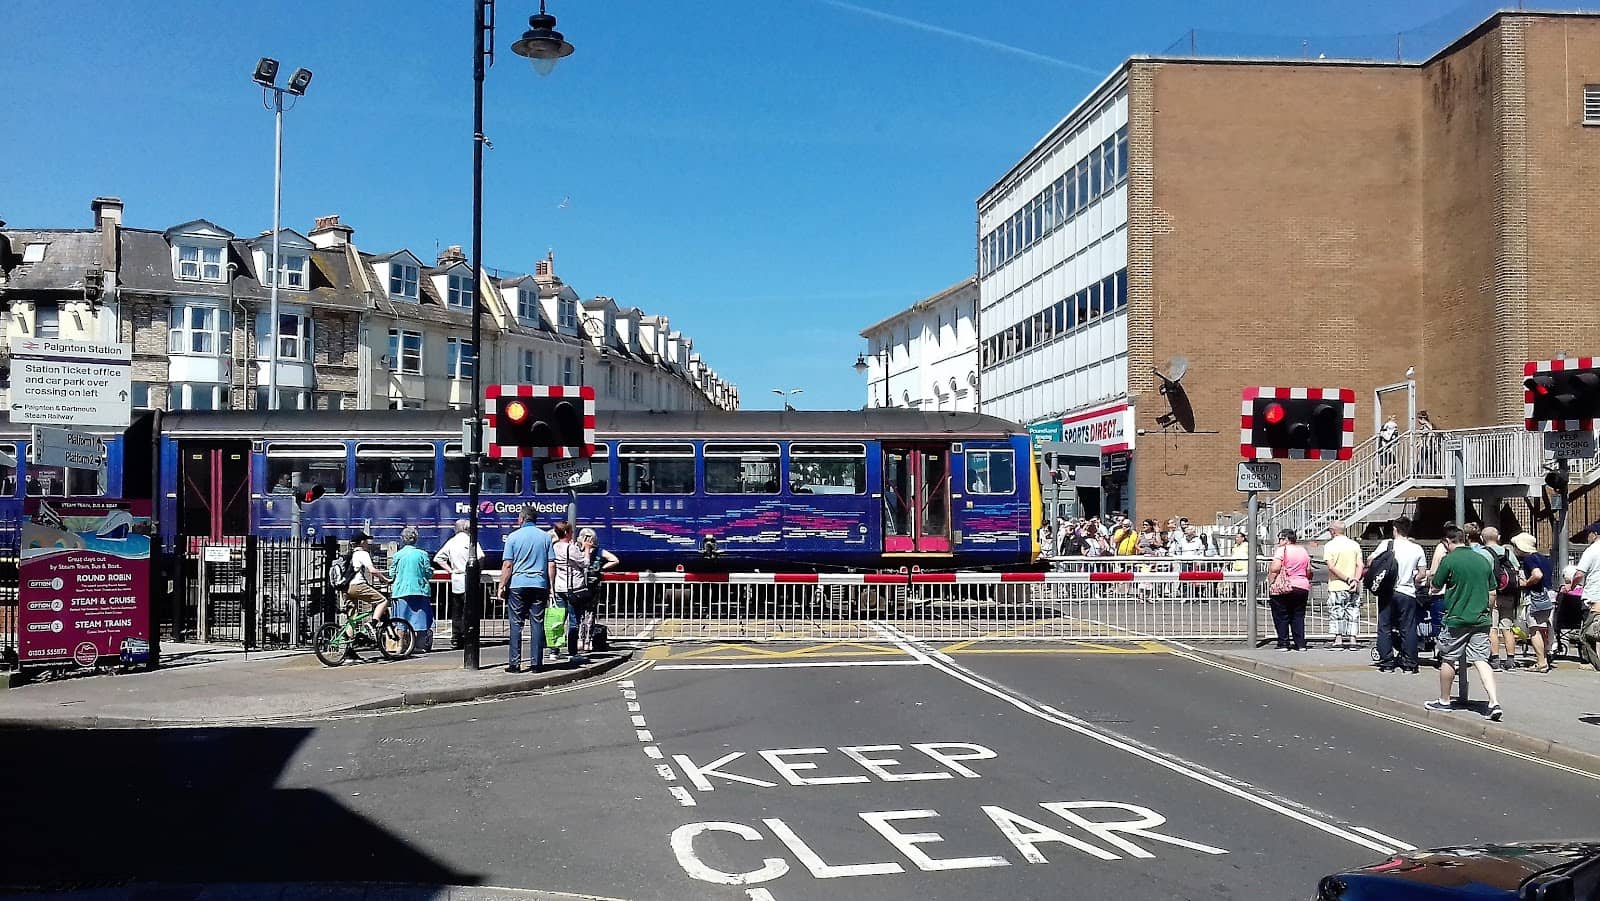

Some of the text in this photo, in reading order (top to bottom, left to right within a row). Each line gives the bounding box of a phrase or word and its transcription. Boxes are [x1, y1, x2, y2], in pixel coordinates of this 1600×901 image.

[44, 343, 122, 355] Paignton Station
[25, 364, 121, 376] Station Ticket office
[25, 376, 44, 384] and
[63, 378, 85, 388] park
[25, 388, 67, 397] crossing
[83, 389, 98, 397] left
[24, 404, 55, 412] Paignton
[24, 412, 74, 421] Steam Railway
[67, 433, 92, 447] Platform
[65, 451, 94, 465] Platform 2
[555, 461, 576, 469] KEEP
[1251, 465, 1269, 473] KEEP
[547, 466, 587, 480] CROSSING
[556, 477, 581, 486] CLEAR
[1248, 481, 1271, 489] CLEAR
[455, 501, 480, 513] Fir
[526, 501, 569, 513] Wester
[76, 573, 132, 582] ROUND ROBIN
[71, 597, 97, 606] STEAM
[109, 596, 136, 605] CRUISE
[74, 619, 132, 629] STEAM TRAINS
[672, 742, 998, 791] KEEP
[669, 800, 1230, 886] CLEAR
